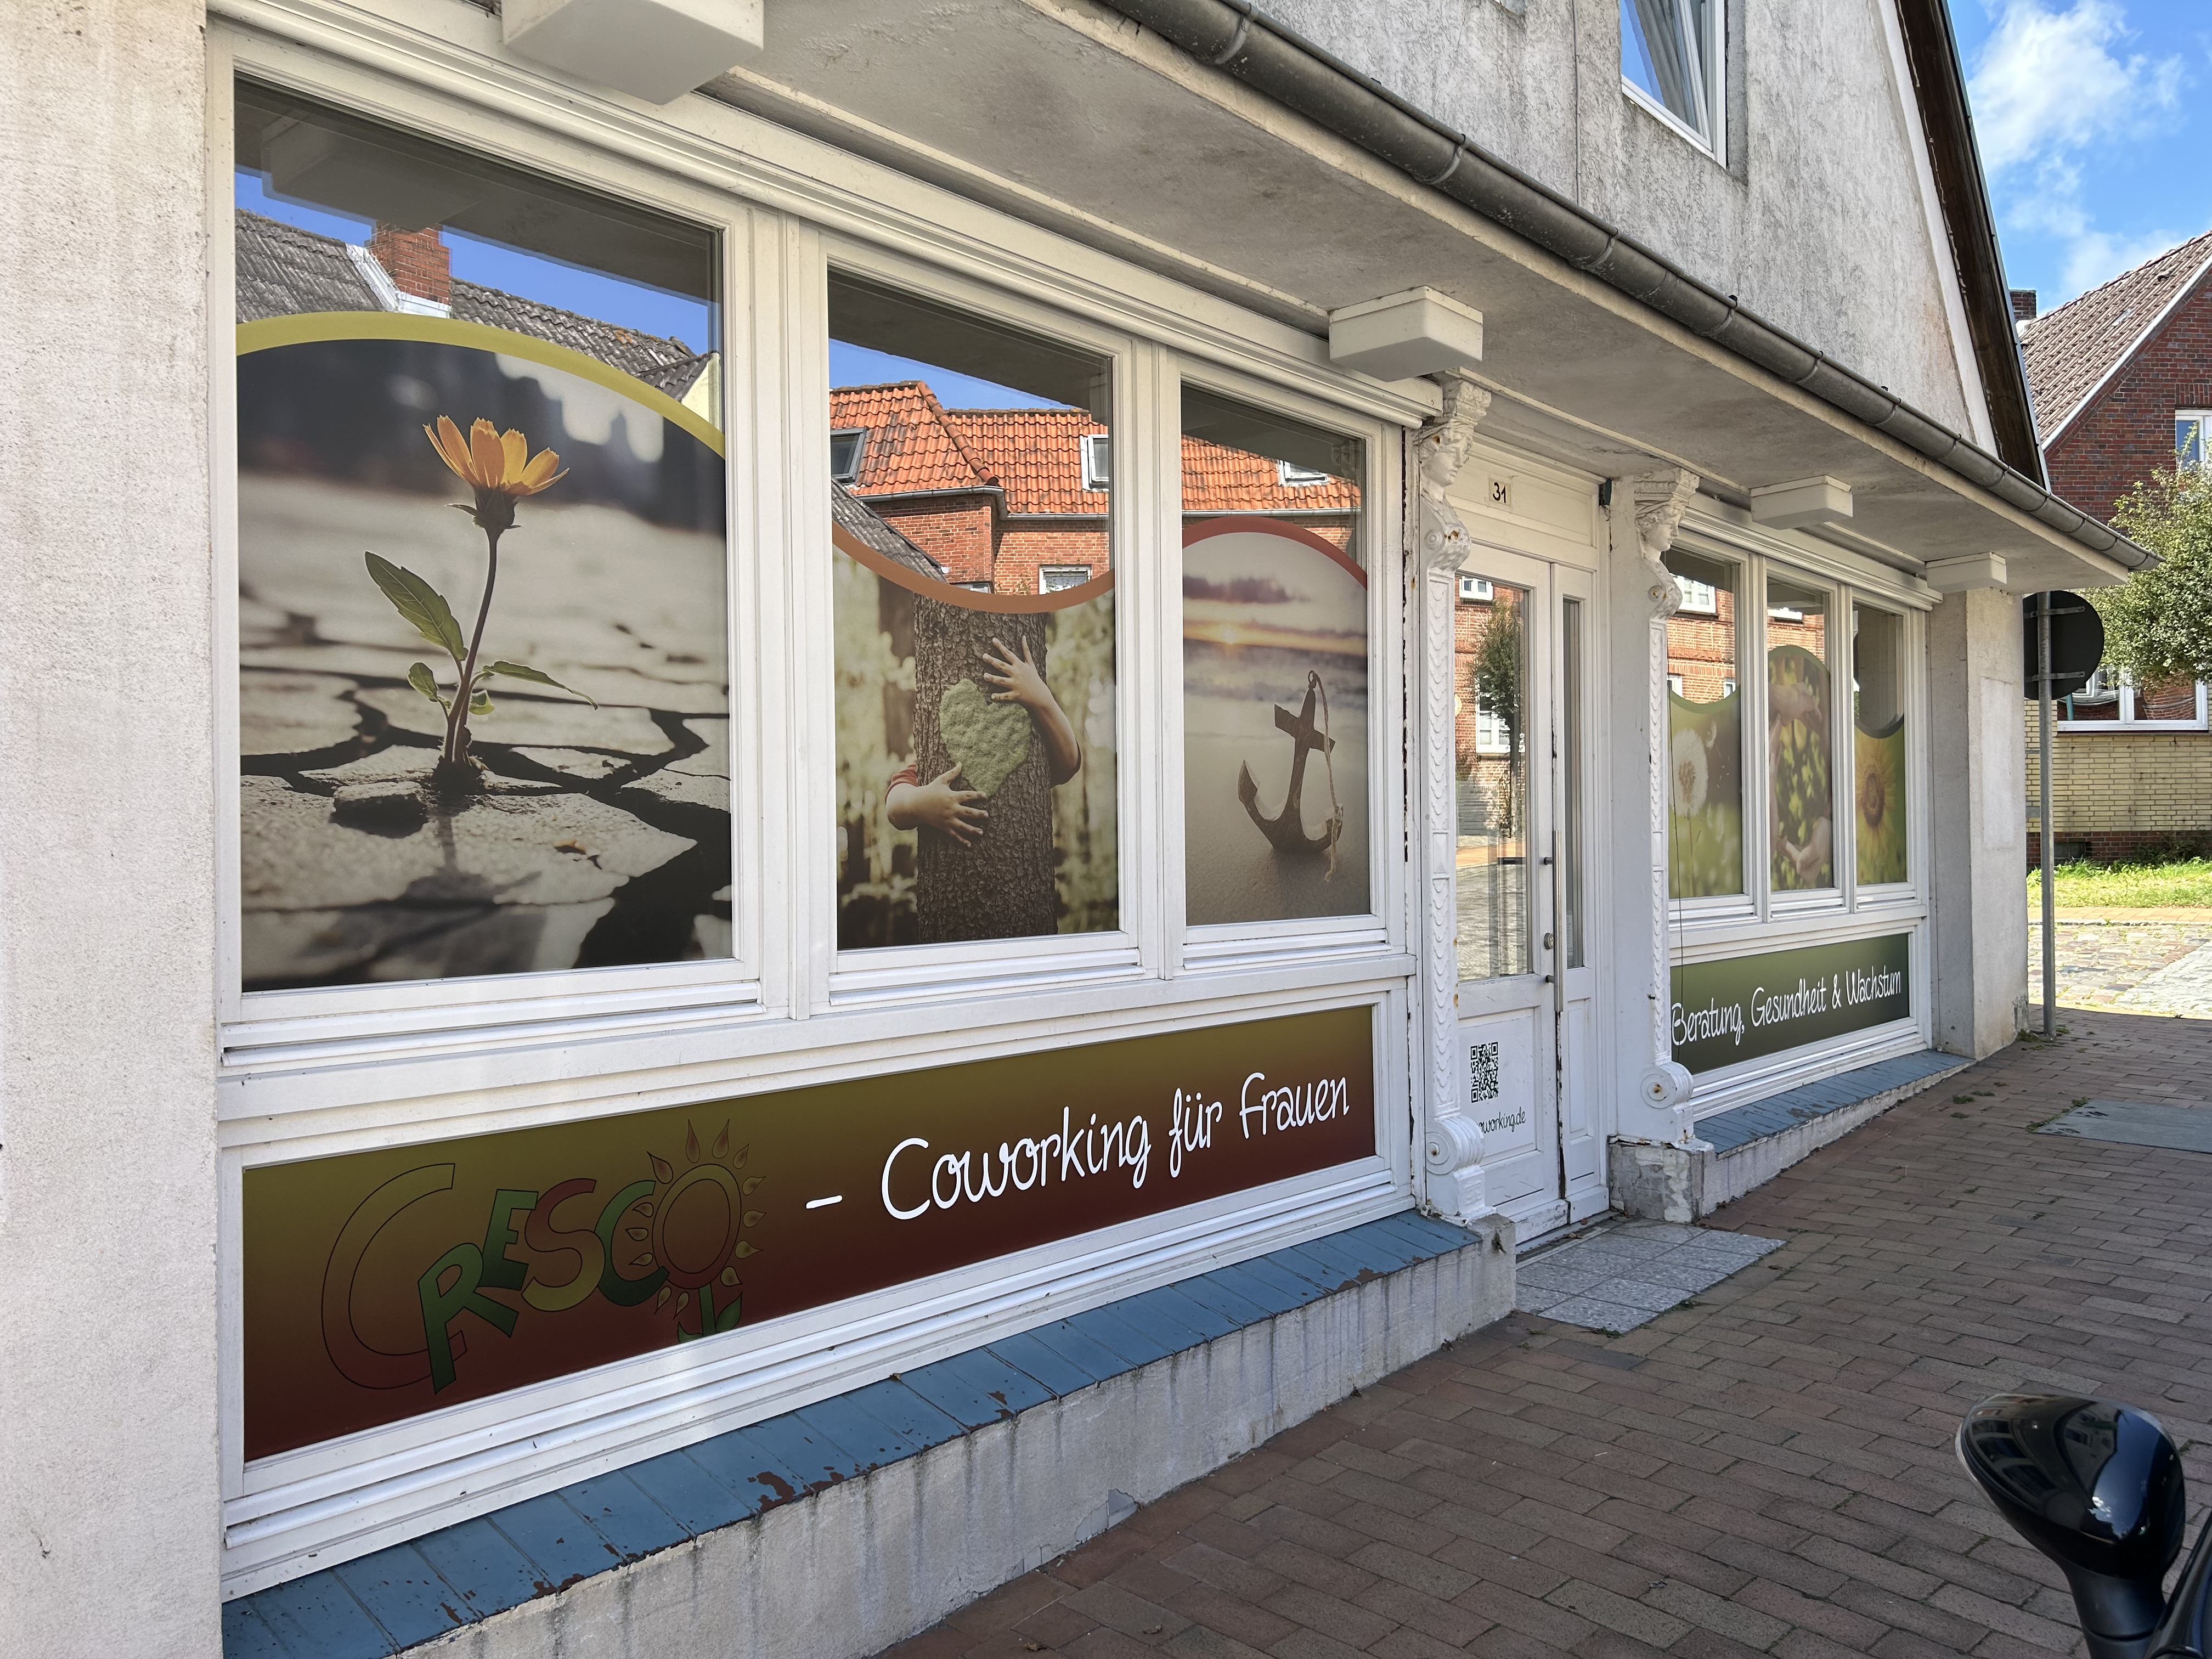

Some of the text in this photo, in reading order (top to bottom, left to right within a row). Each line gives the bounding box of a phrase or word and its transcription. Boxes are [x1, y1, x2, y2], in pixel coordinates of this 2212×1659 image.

[1492, 482, 1506, 504] 31
[1671, 964, 1901, 1046] Beratung, Gesundheit & Wachstum
[1476, 1106, 1526, 1133] oworking.de
[321, 1161, 742, 1395] CRESCO
[881, 1105, 1151, 1220] Coworking
[1169, 1087, 1222, 1178] für
[1239, 1072, 1350, 1139] Frauen
